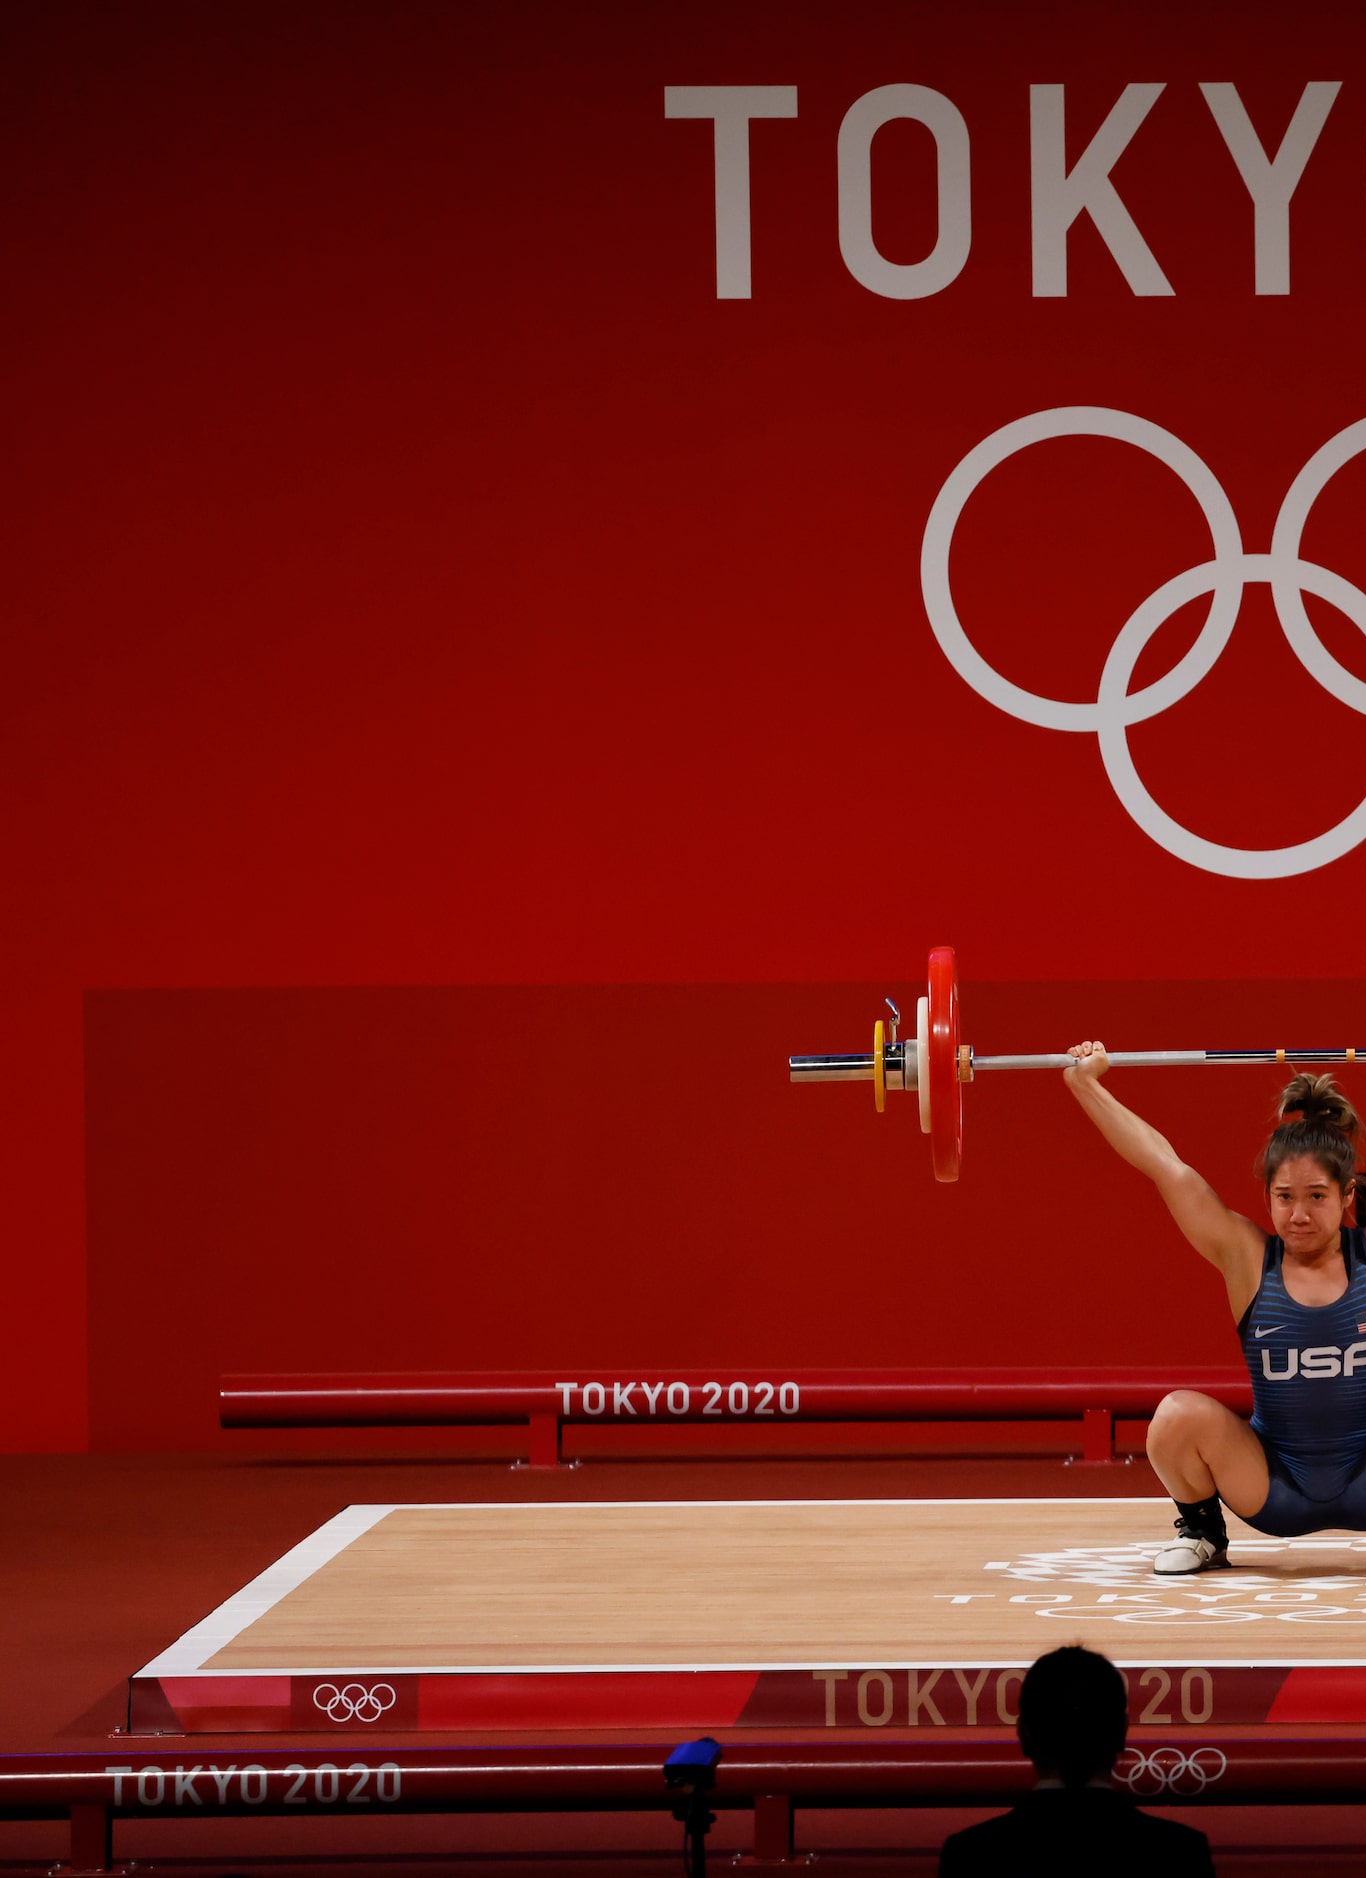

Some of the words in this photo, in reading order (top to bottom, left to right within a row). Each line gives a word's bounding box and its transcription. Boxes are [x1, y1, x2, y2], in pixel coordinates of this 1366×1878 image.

[555, 1381, 691, 1416] TOKYO
[702, 1380, 801, 1415] 2020
[933, 1591, 1319, 1604] TOKYO
[1120, 1667, 1214, 1724] 20
[104, 1763, 269, 1807] TOKYO
[282, 1761, 403, 1805] 2020
